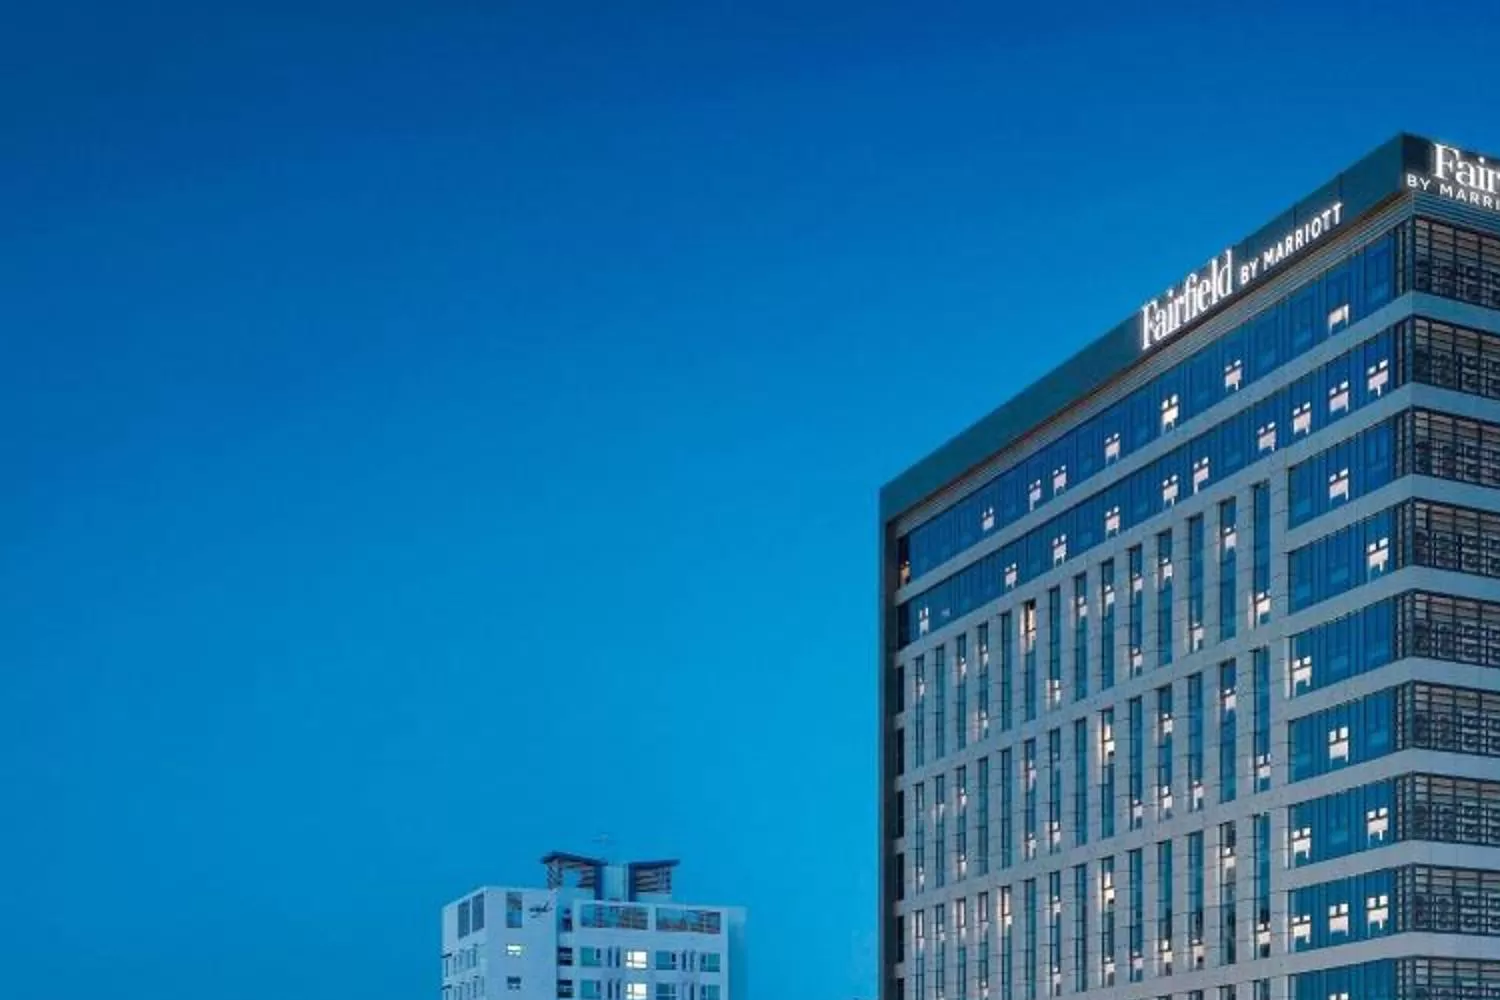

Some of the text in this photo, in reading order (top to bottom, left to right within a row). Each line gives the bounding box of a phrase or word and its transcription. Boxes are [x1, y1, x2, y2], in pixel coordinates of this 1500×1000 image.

[1407, 173, 1431, 191] BY
[1141, 202, 1343, 350] Fairfield BY MARRIOTT
